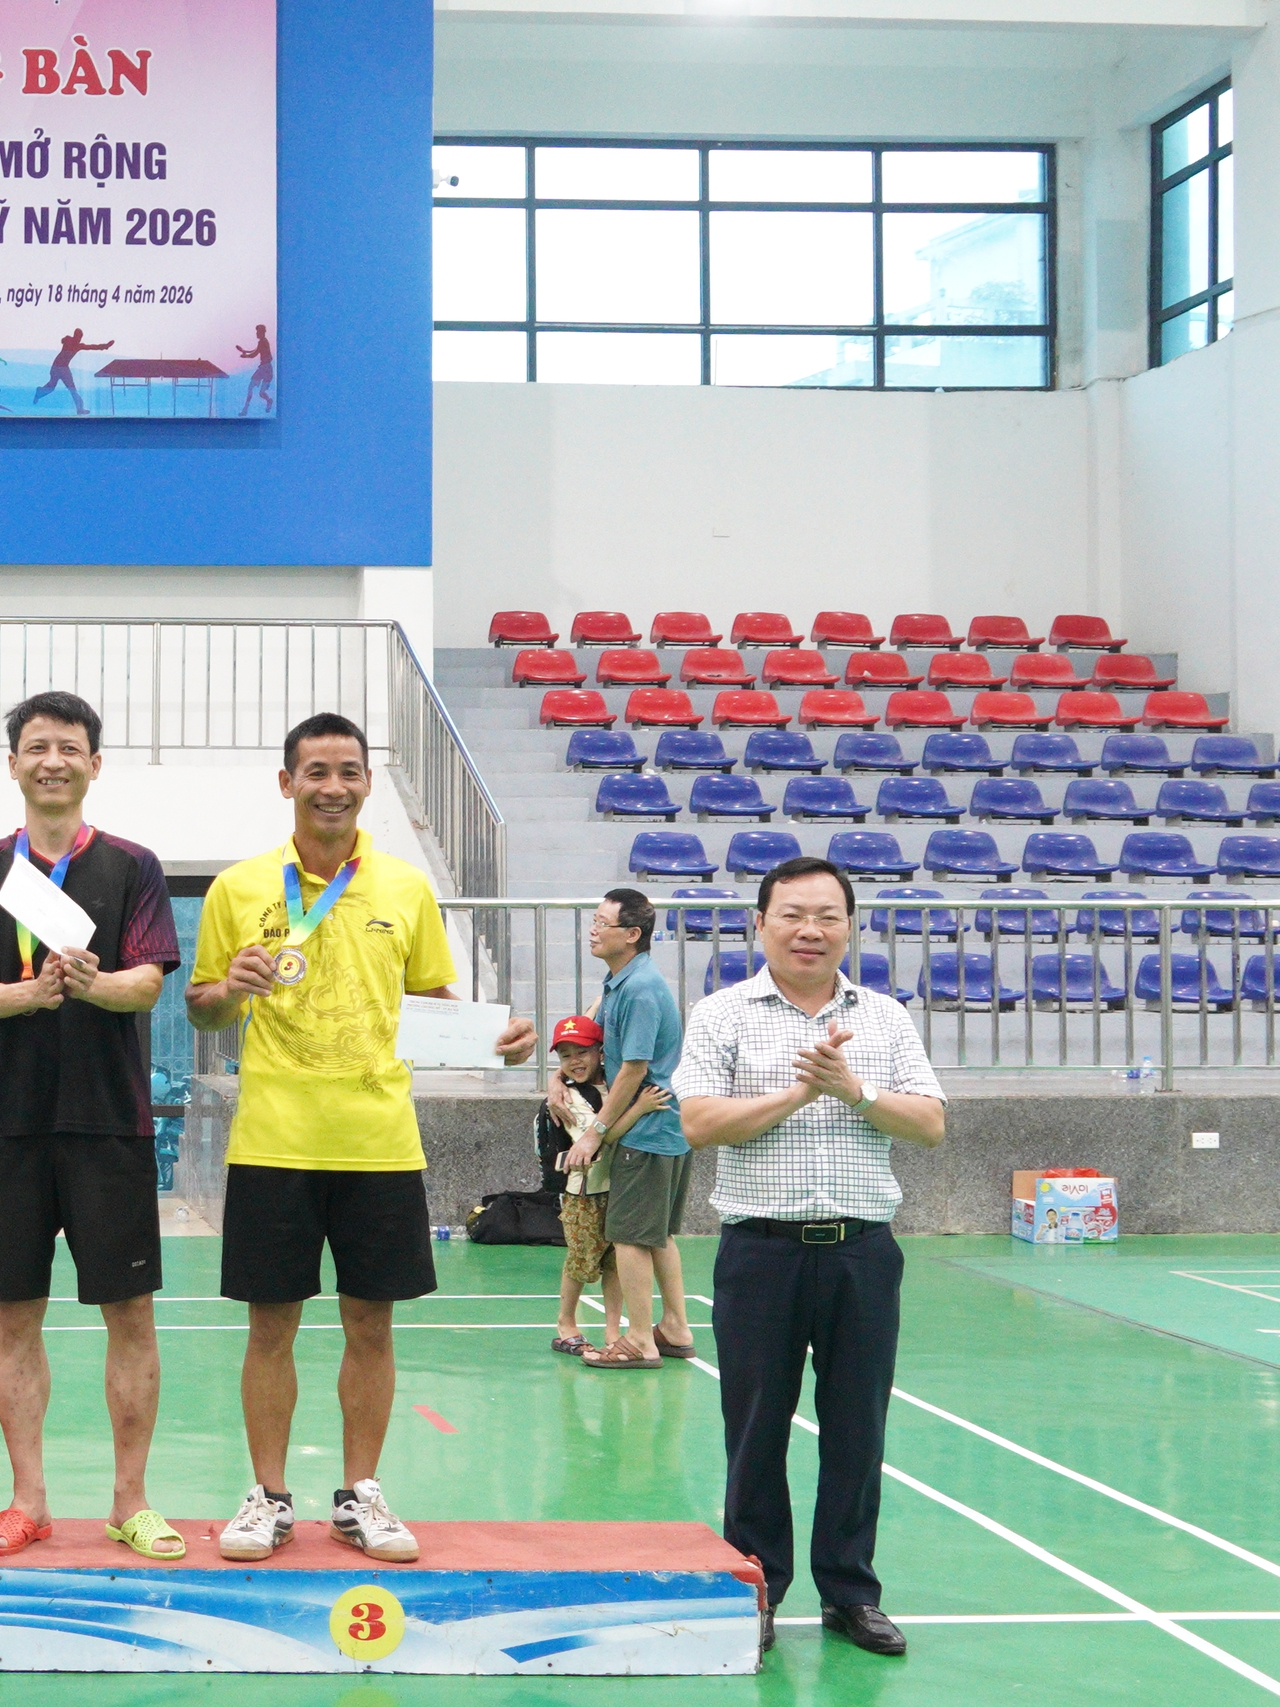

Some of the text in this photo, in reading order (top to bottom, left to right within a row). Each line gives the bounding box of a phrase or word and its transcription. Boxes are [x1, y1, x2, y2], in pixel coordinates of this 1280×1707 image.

[22, 35, 151, 96] BÀN
[63, 133, 167, 188] RỘNG
[24, 198, 111, 245] NĂM
[125, 208, 216, 247] 2026
[6, 283, 43, 307] ngày
[48, 284, 63, 303] 18
[67, 283, 108, 308] tháng
[111, 285, 121, 303] 4
[124, 285, 156, 304] năm
[159, 285, 193, 304] 2026
[348, 1602, 386, 1641] 3
